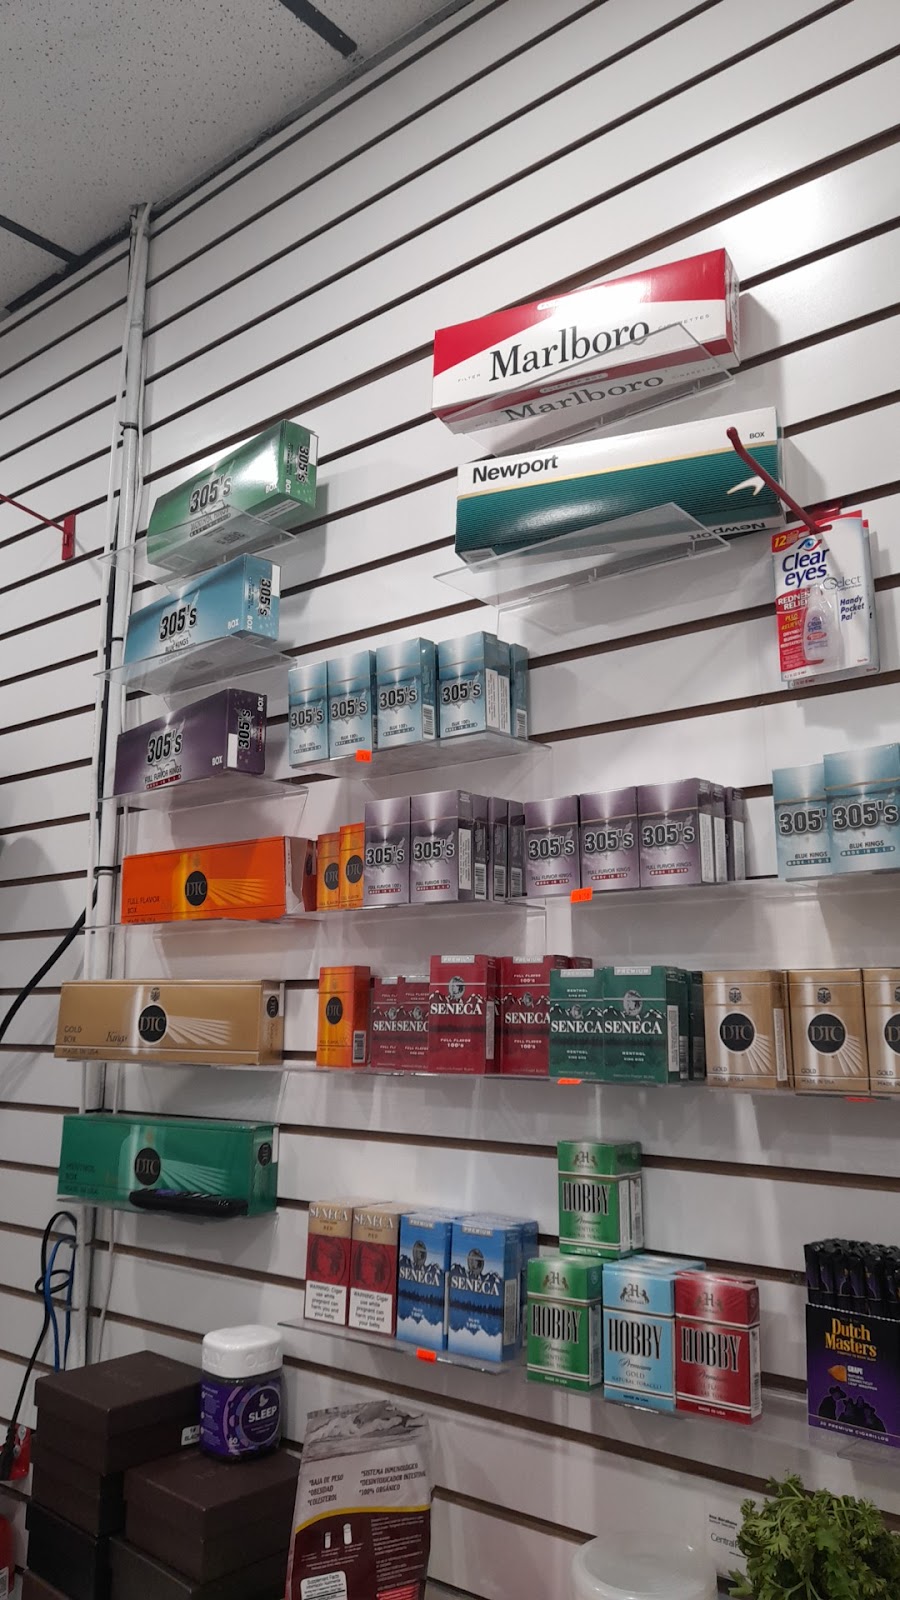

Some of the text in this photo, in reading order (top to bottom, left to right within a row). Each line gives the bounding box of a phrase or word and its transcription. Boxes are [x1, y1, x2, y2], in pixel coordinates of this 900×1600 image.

[488, 320, 650, 383] Marlboro
[457, 372, 482, 383] FILTER
[501, 374, 664, 423] Marlboro
[748, 430, 766, 440] BOX
[471, 454, 559, 484] Newport
[265, 483, 279, 495] BOX
[284, 478, 293, 495] BOX
[688, 520, 767, 543] Newport
[774, 535, 788, 549] 12
[782, 547, 830, 573] Clear
[785, 563, 828, 589] eyes
[840, 594, 864, 607] Handy
[840, 602, 865, 615] Pocket
[227, 618, 240, 629] BOX
[841, 612, 854, 623] Pal
[211, 755, 223, 767] BOX
[779, 807, 828, 836] 305'
[849, 840, 885, 850] BLUE KINGS
[809, 851, 828, 859] KINGS
[347, 861, 363, 878] DTC
[187, 880, 206, 898] DTC
[140, 895, 160, 904] FLAVOR
[128, 906, 137, 915] BOX
[616, 967, 651, 975] PREMIUM
[327, 1003, 342, 1019] DTC
[430, 1003, 483, 1016] SENECA
[139, 1015, 166, 1033] DTC
[504, 1011, 551, 1024] SENECA
[64, 1025, 82, 1034] GOLD
[550, 1020, 604, 1034] SENECA
[603, 1020, 663, 1035] SENECA
[722, 1023, 753, 1041] DTC
[810, 1025, 843, 1042] DTC
[64, 1035, 77, 1043] BOX
[106, 1031, 128, 1044] Kings
[801, 1067, 817, 1075] GOLD
[877, 1069, 894, 1077] GOLD
[135, 1157, 160, 1175] DTC
[562, 1181, 611, 1216] HOBBY
[309, 1206, 349, 1222] SENECA
[354, 1213, 394, 1229] SENECA
[410, 1219, 434, 1229] PREMIUM
[463, 1226, 492, 1236] PREMIUM
[399, 1266, 440, 1287] SENECA
[331, 1286, 343, 1295] Cigar
[450, 1275, 500, 1297] SENECA
[311, 1298, 329, 1308] pregnant
[376, 1294, 389, 1303] Cigar
[356, 1305, 375, 1315] pregnant
[532, 1304, 581, 1345] HOBBY
[831, 1317, 872, 1342] Dutch
[608, 1318, 663, 1360] HOBBY
[824, 1331, 878, 1359] Masters
[680, 1326, 743, 1372] HOBBY
[618, 1358, 653, 1372] Premium
[847, 1365, 864, 1376] GRAPE
[625, 1369, 646, 1379] GOLD
[248, 1405, 278, 1424] SLEEP
[828, 1422, 854, 1434] PREMIUM
[854, 1429, 890, 1443] CIGARILLOS
[331, 1474, 344, 1483] PESO
